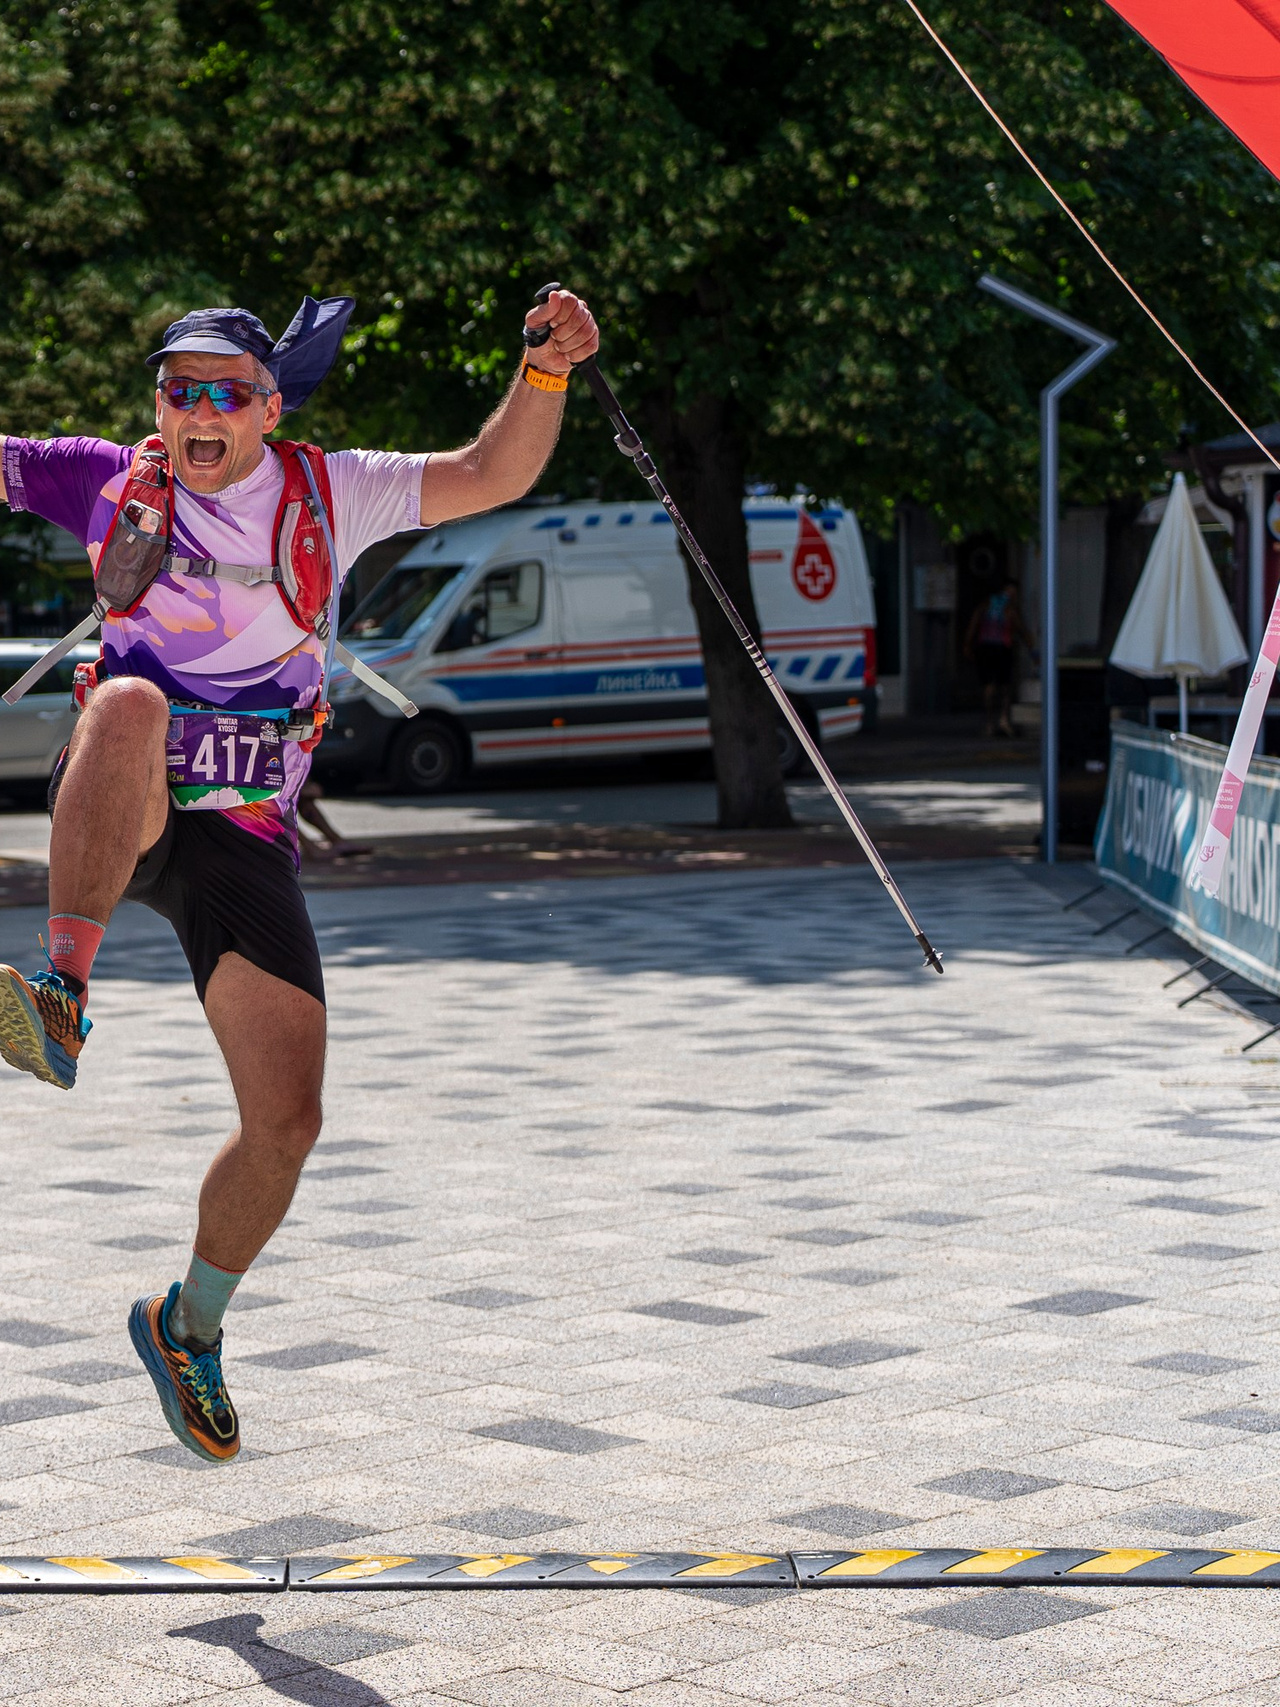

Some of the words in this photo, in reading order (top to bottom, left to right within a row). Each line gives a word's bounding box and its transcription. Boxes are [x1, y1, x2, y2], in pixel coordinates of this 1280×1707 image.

[13, 465, 23, 482] HEART
[595, 668, 681, 692] ЛИНЕЙКА
[217, 717, 238, 726] DIMITAR
[217, 725, 238, 733] KYOSEV
[192, 733, 260, 783] 417
